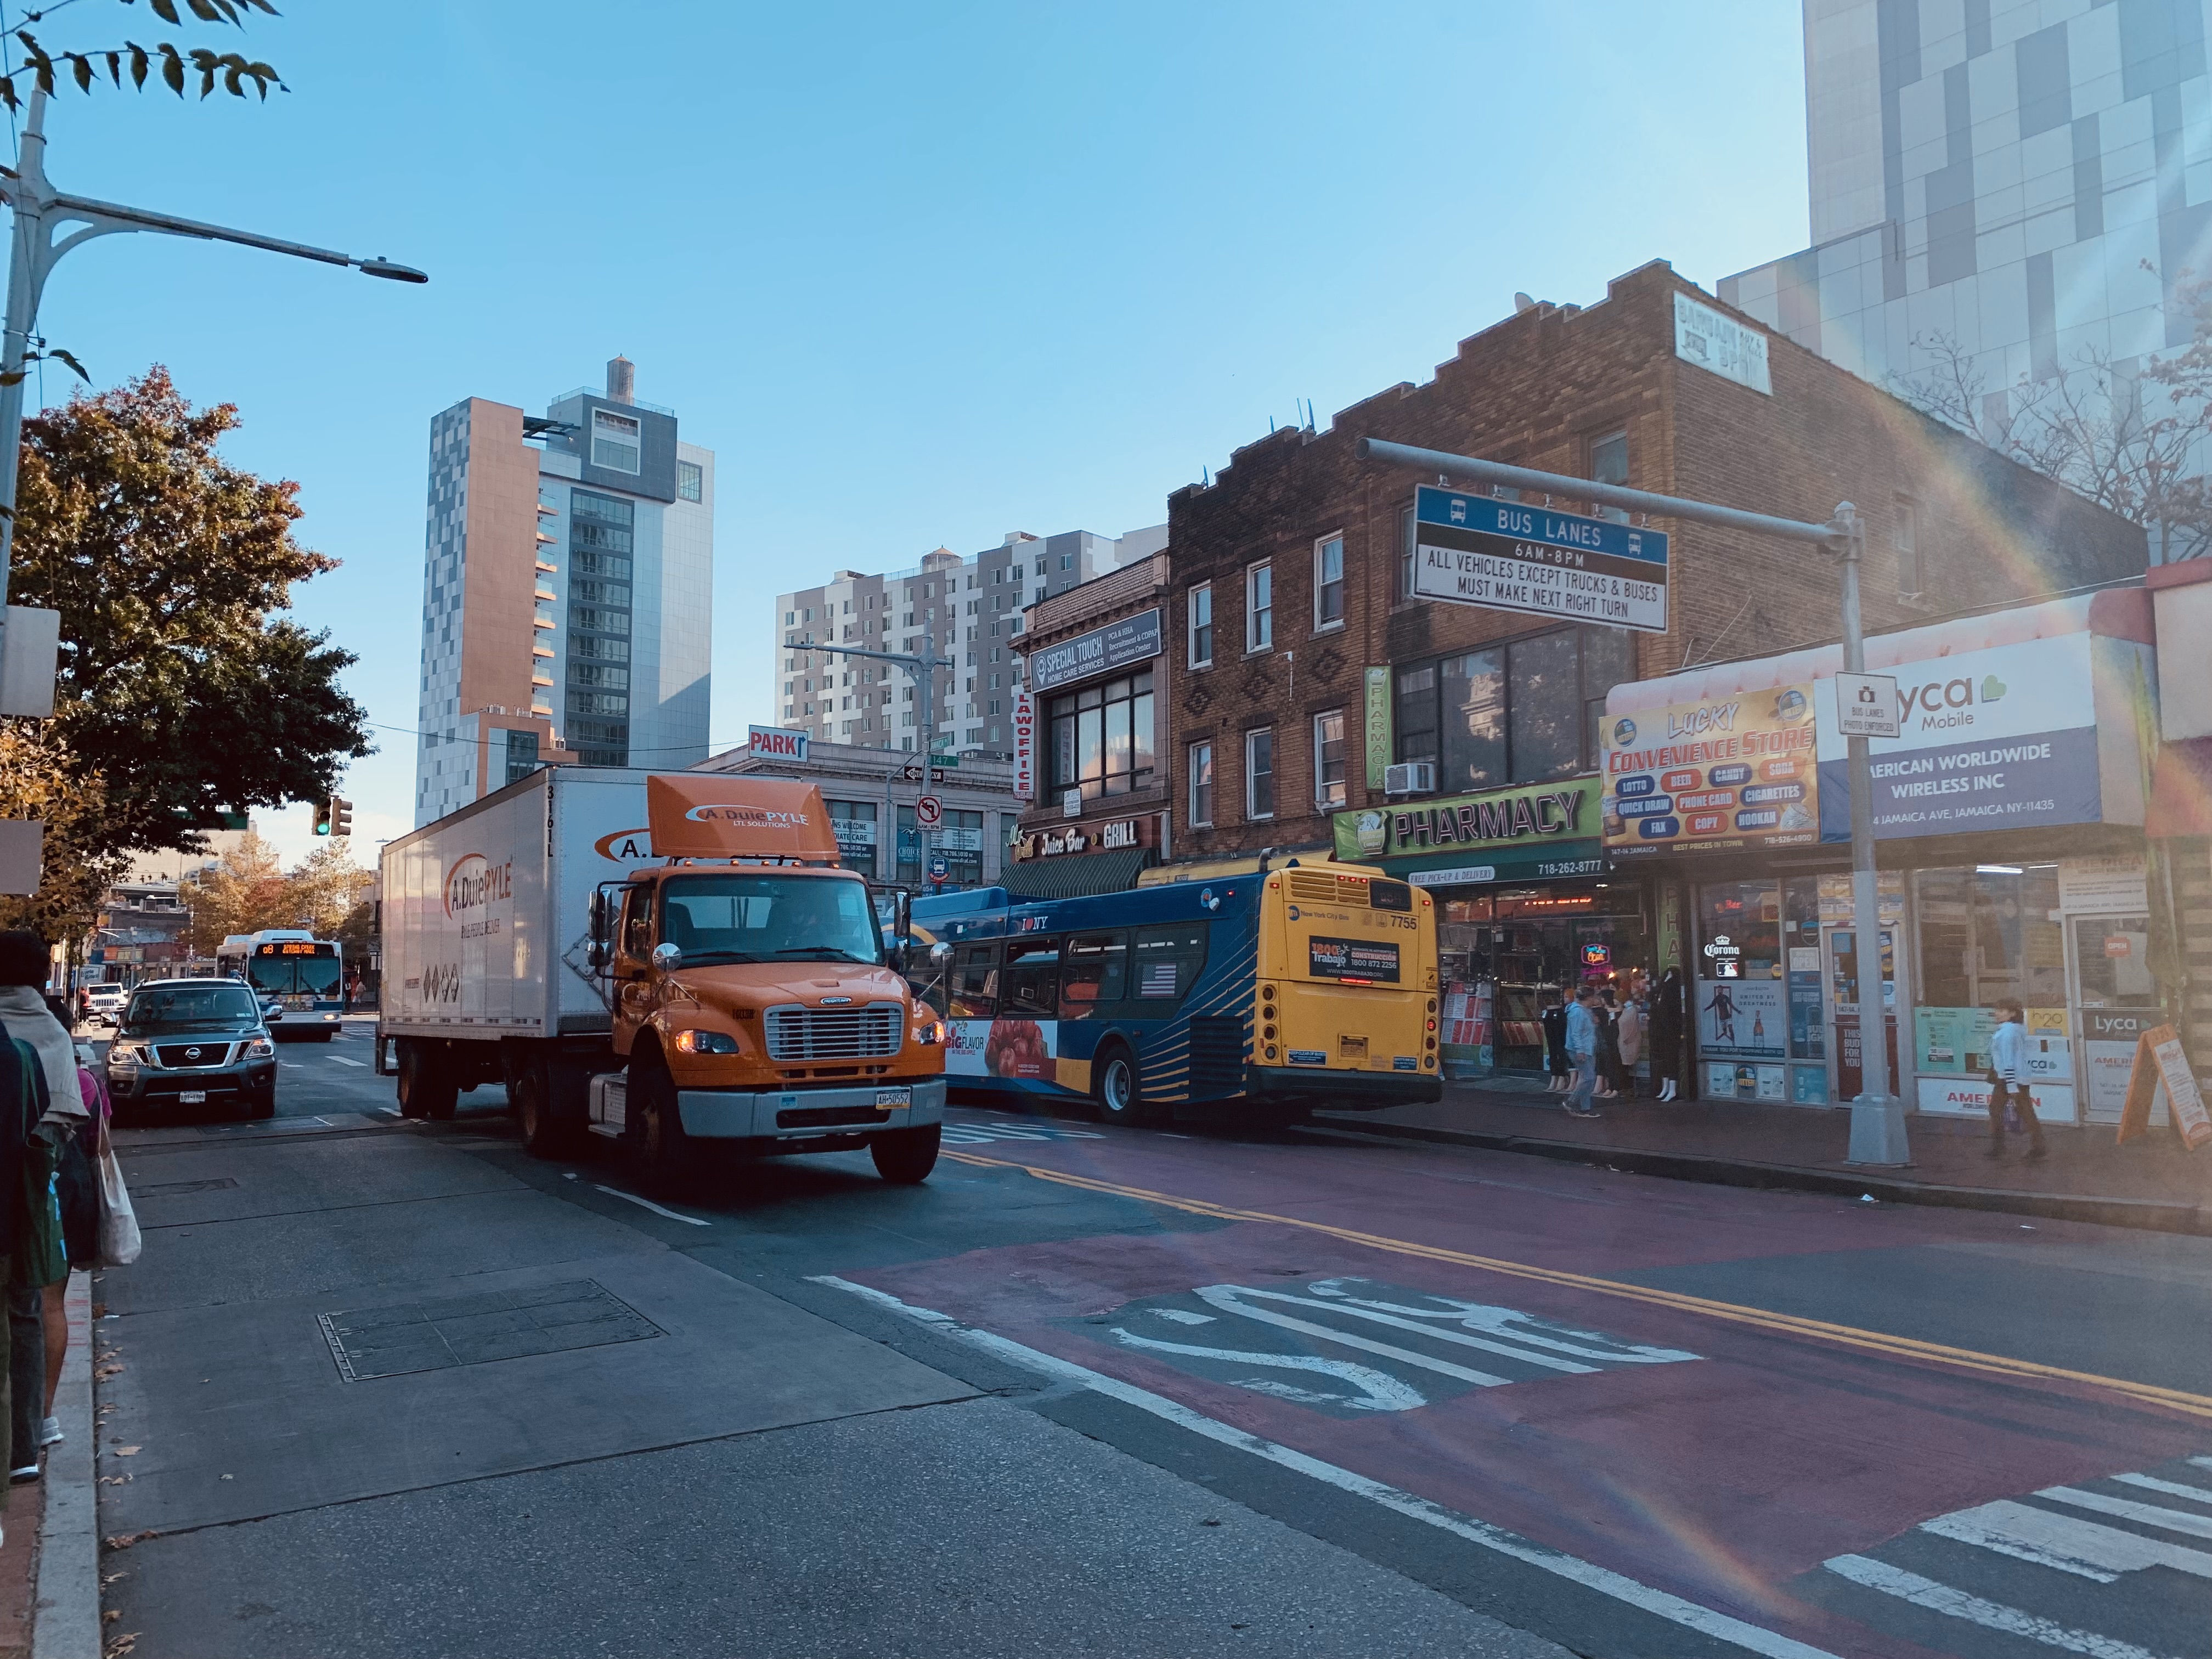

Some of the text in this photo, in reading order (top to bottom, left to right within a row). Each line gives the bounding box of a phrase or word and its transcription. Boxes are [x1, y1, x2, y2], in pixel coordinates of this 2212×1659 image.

[1498, 509, 1601, 546] BUS LANES
[1428, 550, 1657, 602] ALL VEHICLES EXCEPT TRUCKS & BUSES
[1458, 577, 1628, 618] MUST MAKE NEXT RIGHT TURN
[1108, 632, 1118, 641] PCA
[1122, 626, 1133, 636] HHA
[1109, 637, 1137, 651] Recruitment
[1141, 628, 1158, 640] CDPAP
[1047, 636, 1103, 673] SPECIAL TOUCH
[1109, 642, 1152, 662] Application Center
[1048, 657, 1104, 684] HOME CARE SERVICES
[1897, 676, 1973, 724] yca
[1852, 707, 1884, 718] BUS LANES
[1667, 702, 1739, 739] LUCKY
[1921, 711, 1974, 731] Mobile
[750, 731, 796, 755] PARK
[1369, 687, 1386, 788] PHARMACIA
[1609, 725, 1813, 776] CONVENIENCE STORE
[1938, 743, 2051, 770] WORLDWIDE
[933, 757, 948, 765] 147
[1671, 774, 1691, 787] BEER
[1715, 767, 1745, 782] CANDY
[1622, 780, 1646, 793] LOTTO
[1891, 773, 2005, 799] WIRELESS INC
[1679, 794, 1707, 809] PHONE
[1745, 785, 1800, 803] CIGARETTES
[1618, 800, 1644, 815] QUICK
[1645, 798, 1670, 811] DRAW
[1881, 812, 1926, 825] JAMAICA
[1928, 809, 1953, 821] AVE,
[1955, 805, 2003, 818] JAMAICA
[2006, 799, 2055, 813] NY-11435
[1393, 789, 1584, 848] PHARMACY
[1694, 816, 1718, 830] COPY
[1738, 811, 1776, 826] HOOKAH
[842, 822, 866, 831] WELCOME
[1651, 821, 1667, 833] FAX
[851, 833, 867, 842] CARE
[1041, 832, 1064, 856] Juice
[1065, 827, 1085, 852] Bar
[1103, 820, 1137, 849] GRILL
[1629, 846, 1657, 854] JAMAICA
[1538, 859, 1602, 875] 718-262-8777
[1410, 873, 1426, 883] FREE
[1427, 872, 1453, 882] PICK-UP
[1462, 870, 1493, 879] DELIVERY
[1022, 916, 1048, 931] I NY
[1391, 915, 1417, 930] 7755
[1312, 943, 1338, 956] 1800
[1704, 943, 1740, 958] Corona
[1311, 951, 1346, 968] Trabajo
[1351, 959, 1367, 967] 1800
[1327, 968, 1384, 978] WWW.1800TRABAJO.ORG
[2095, 1015, 2137, 1032] Lyca
[1843, 1029, 1860, 1038] THIS
[962, 1036, 984, 1049] FLAVOR
[1844, 1039, 1860, 1048] BUD
[1844, 1048, 1860, 1058] FOR
[1844, 1057, 1860, 1067] YOU
